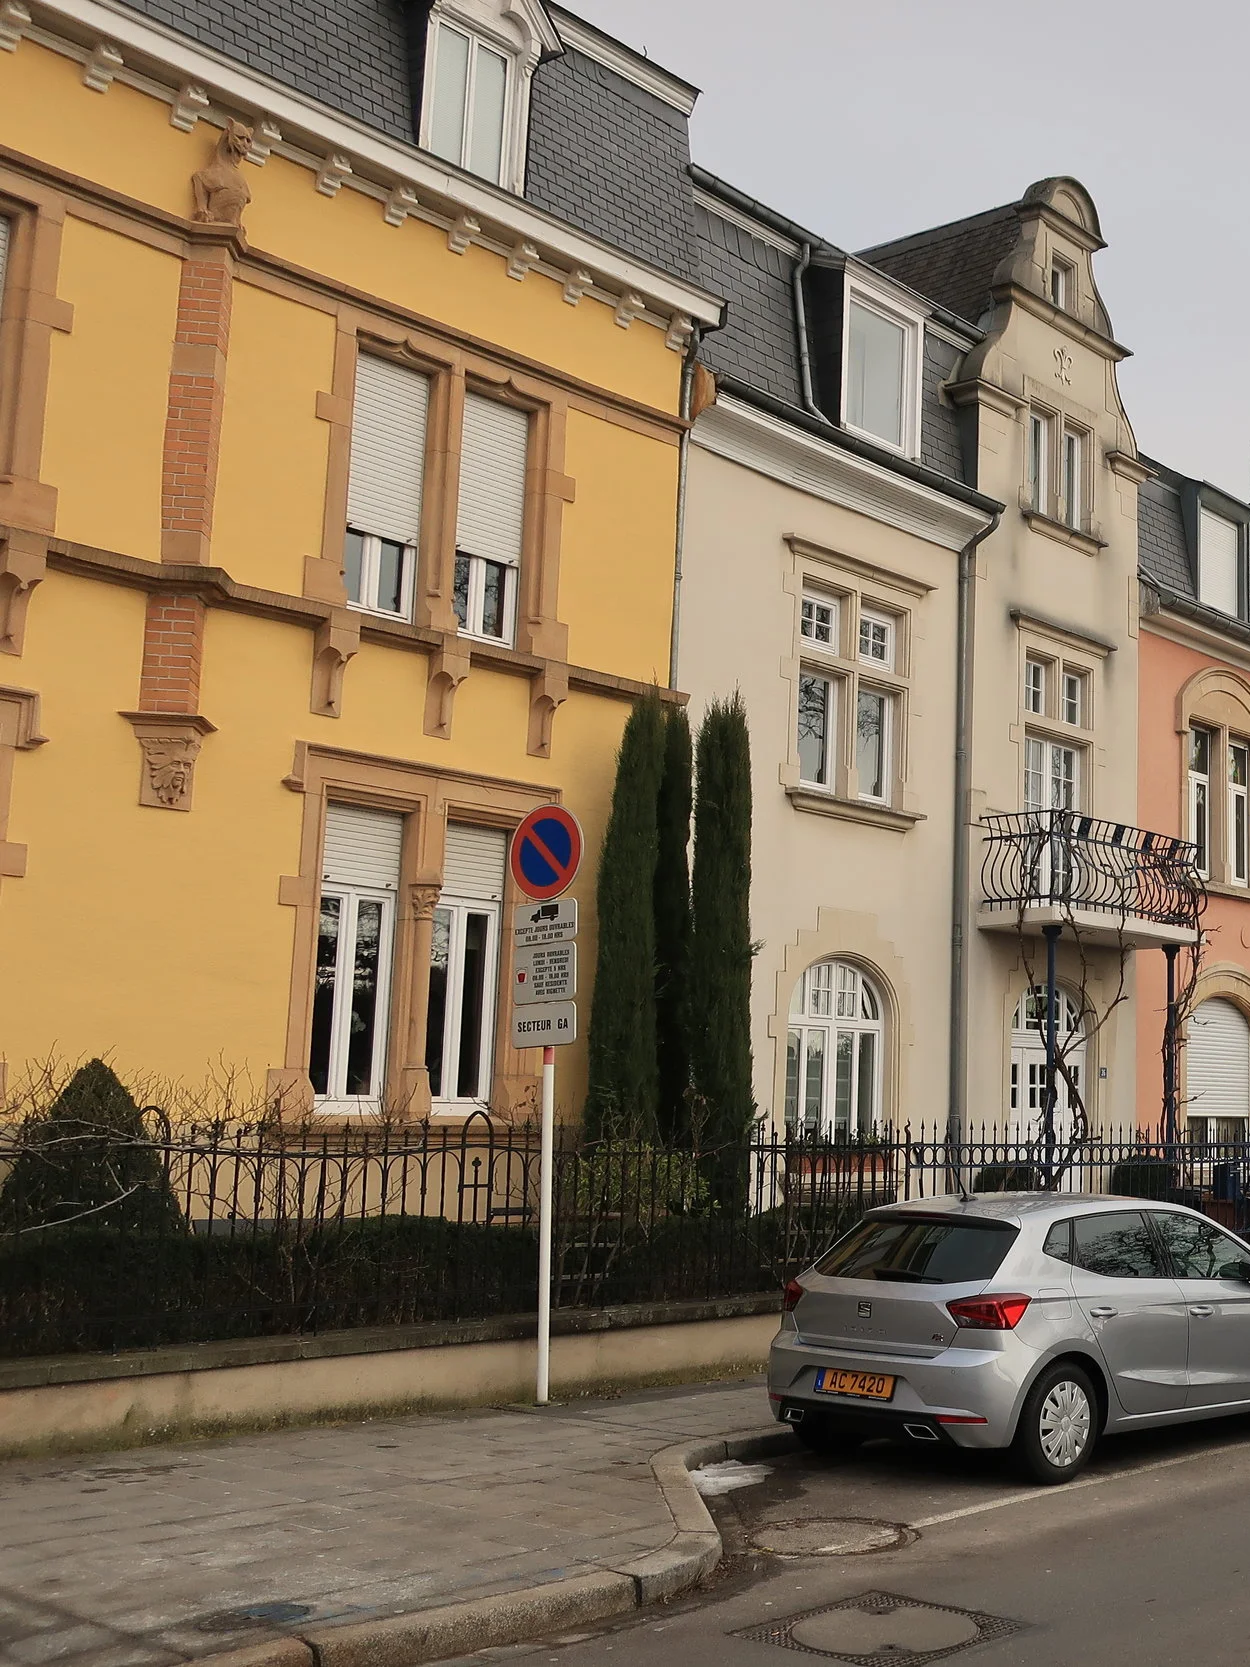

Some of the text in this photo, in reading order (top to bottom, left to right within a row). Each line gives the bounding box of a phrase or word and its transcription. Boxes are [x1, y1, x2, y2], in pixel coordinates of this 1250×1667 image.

[534, 925, 548, 933] JOURS
[549, 921, 574, 931] OUVRABLES
[546, 949, 570, 957] OUVRABLES
[549, 957, 569, 965] VENDREDI
[545, 979, 567, 987] RESIDENTS
[517, 1017, 568, 1033] SECTEUR GA
[829, 1371, 848, 1389] AC
[848, 1373, 885, 1394] 7420
